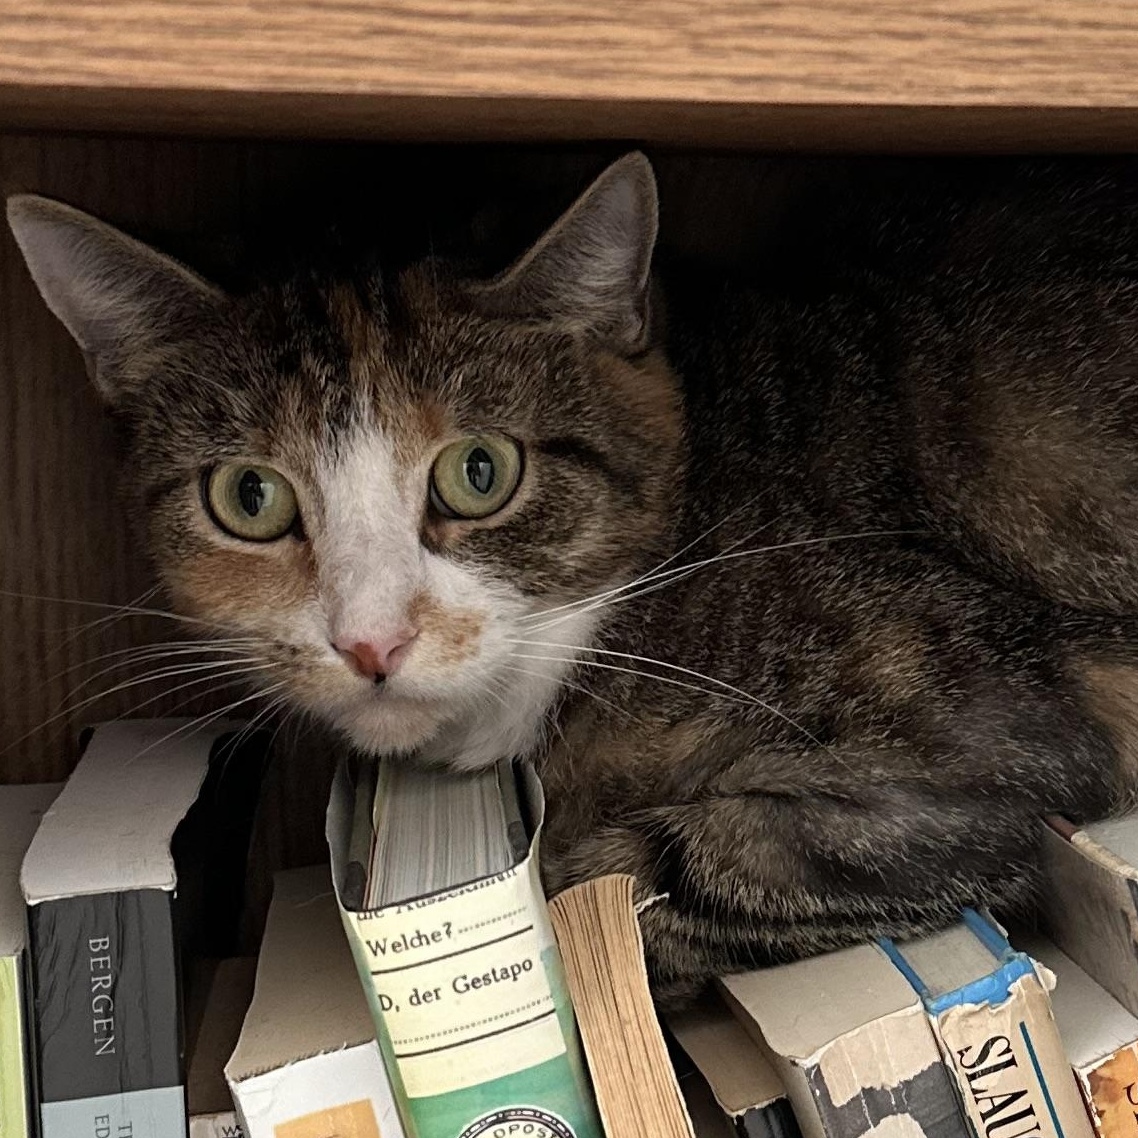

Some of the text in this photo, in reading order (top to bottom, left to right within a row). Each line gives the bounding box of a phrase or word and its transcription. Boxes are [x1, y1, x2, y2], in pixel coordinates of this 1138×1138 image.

[366, 922, 452, 957] Welche?
[88, 936, 116, 1057] BERGEN
[408, 987, 443, 1008] der
[452, 957, 533, 995] Gestapo
